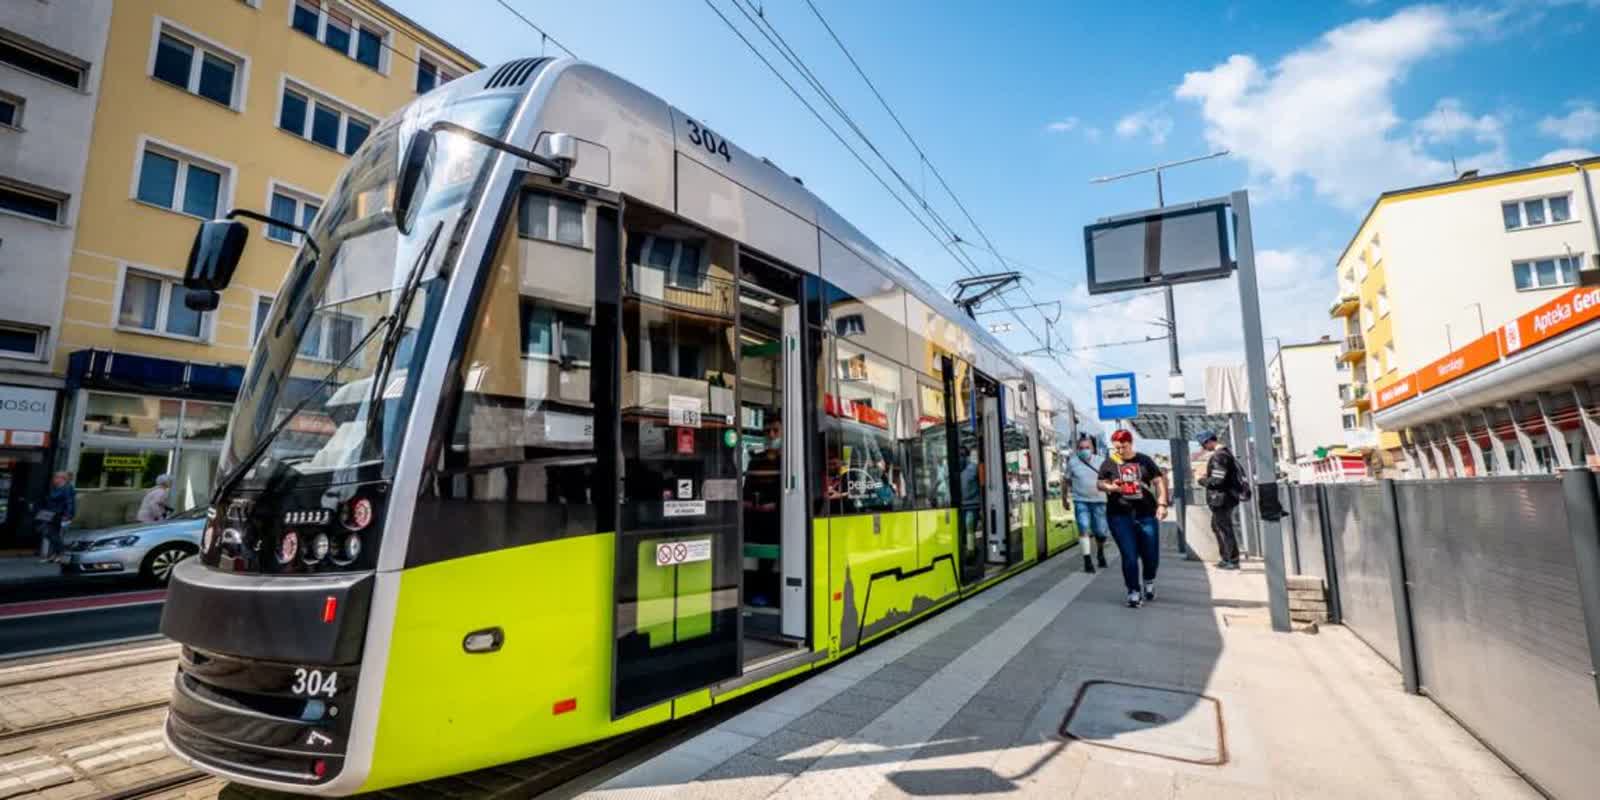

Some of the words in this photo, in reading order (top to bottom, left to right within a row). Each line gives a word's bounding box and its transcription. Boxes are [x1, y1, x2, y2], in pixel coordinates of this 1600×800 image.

[686, 119, 732, 163] 304
[1534, 303, 1572, 335] Apteka
[0, 397, 48, 413] OŚCI
[291, 668, 338, 698] 304
